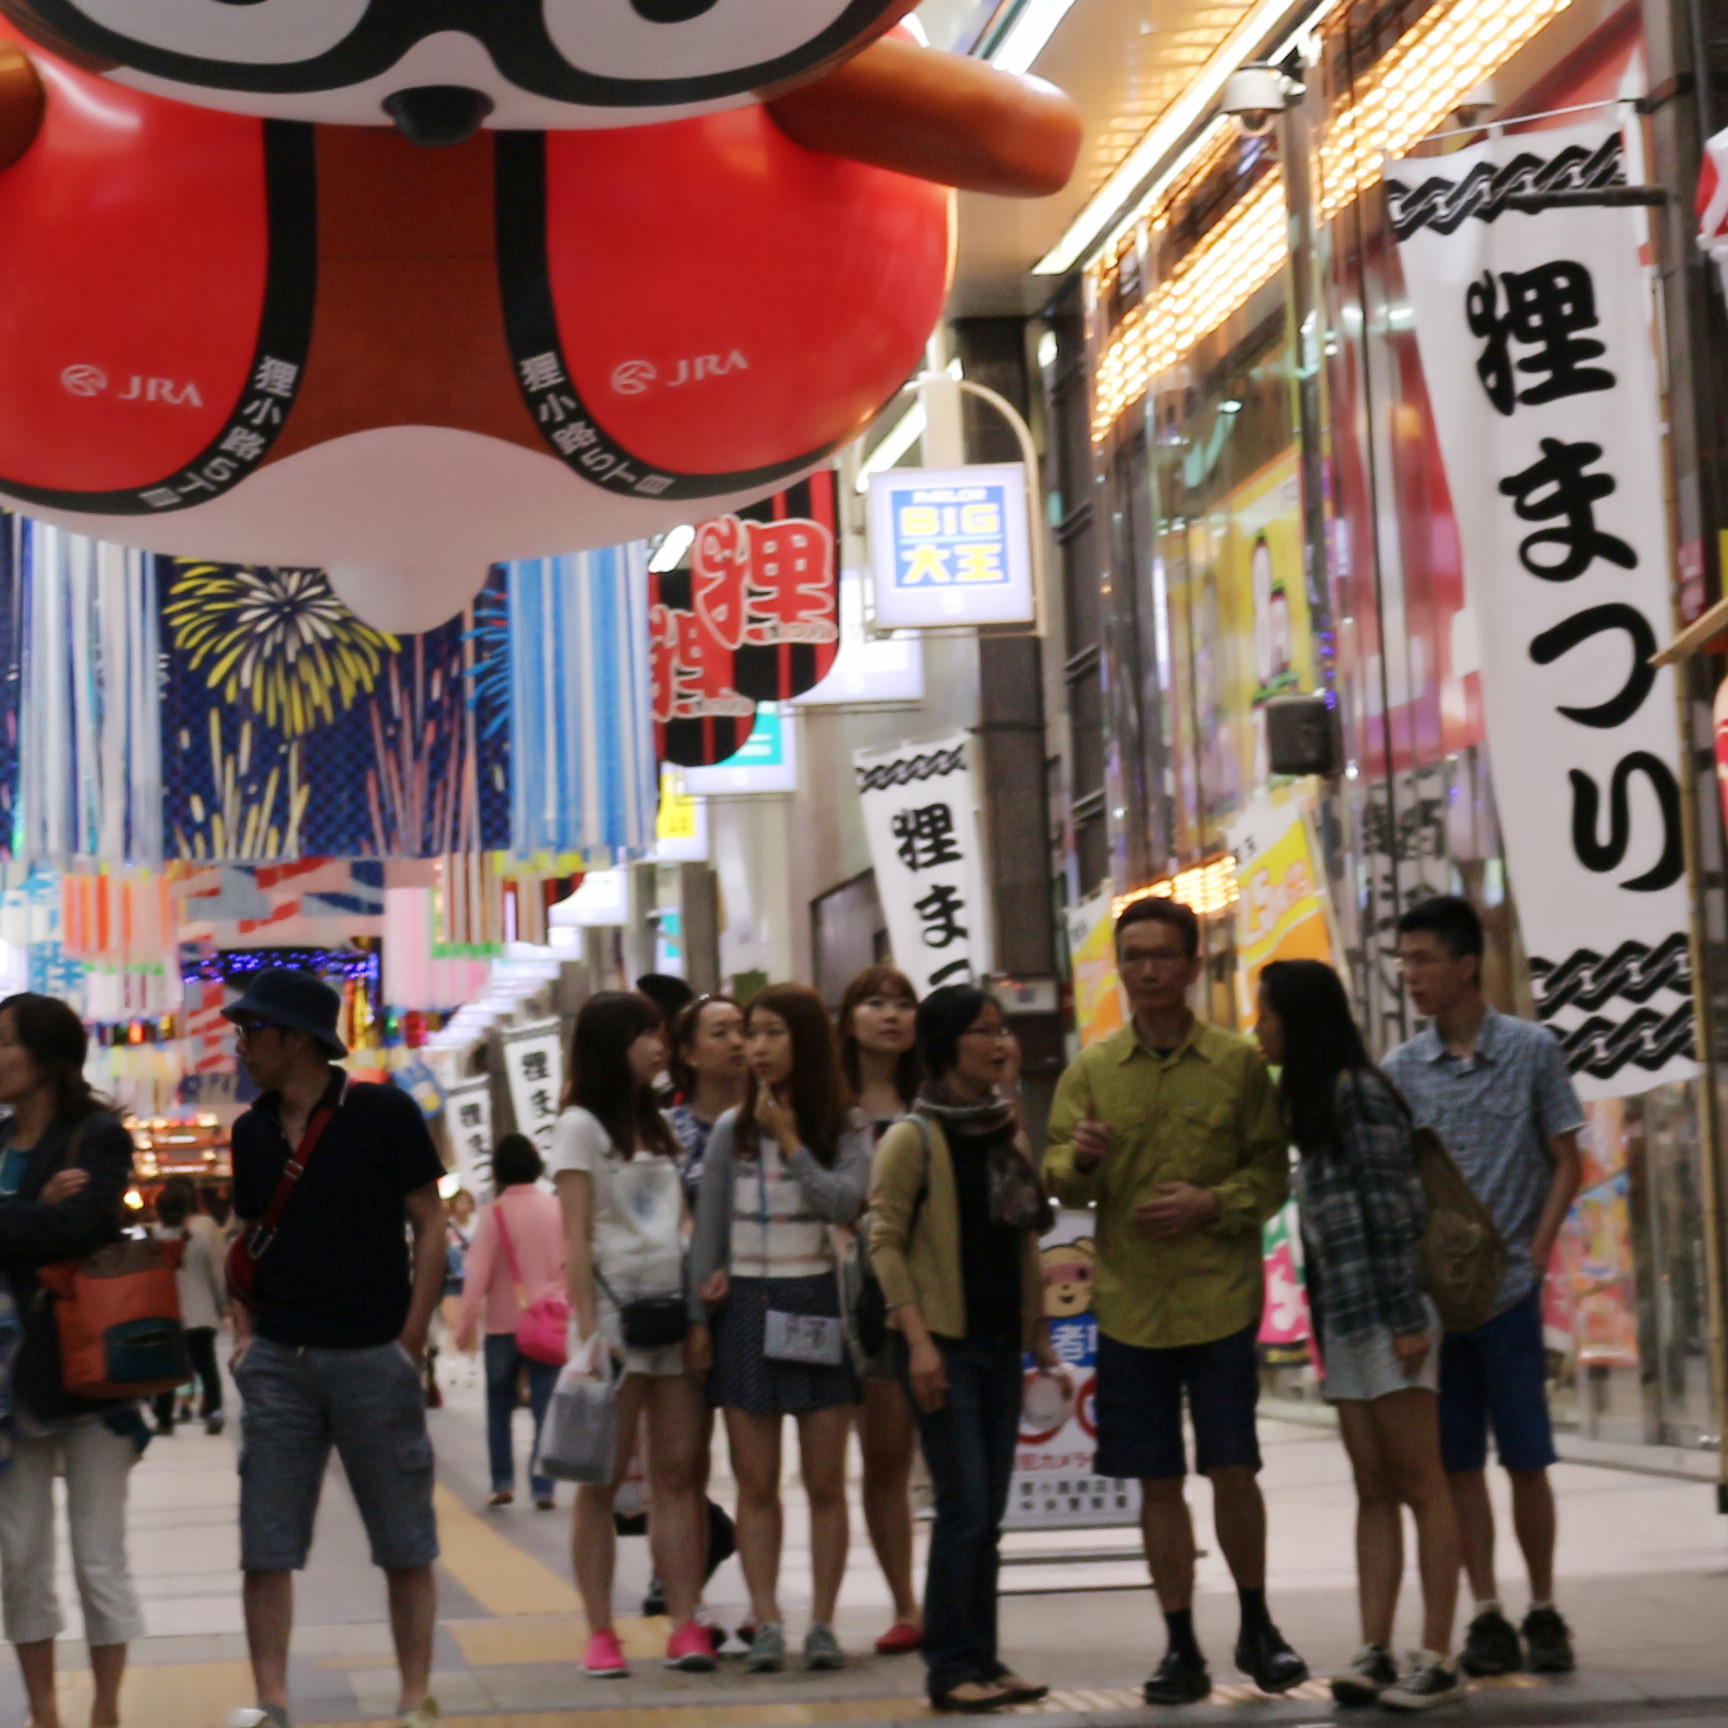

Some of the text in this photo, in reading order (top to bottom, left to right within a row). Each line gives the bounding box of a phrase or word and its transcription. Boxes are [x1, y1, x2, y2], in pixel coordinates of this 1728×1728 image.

[665, 349, 749, 387] JRA
[118, 376, 203, 407] JRA
[902, 503, 1000, 536] BIG
[901, 543, 1004, 584] 大王
[1466, 260, 1686, 892] 狸まつり
